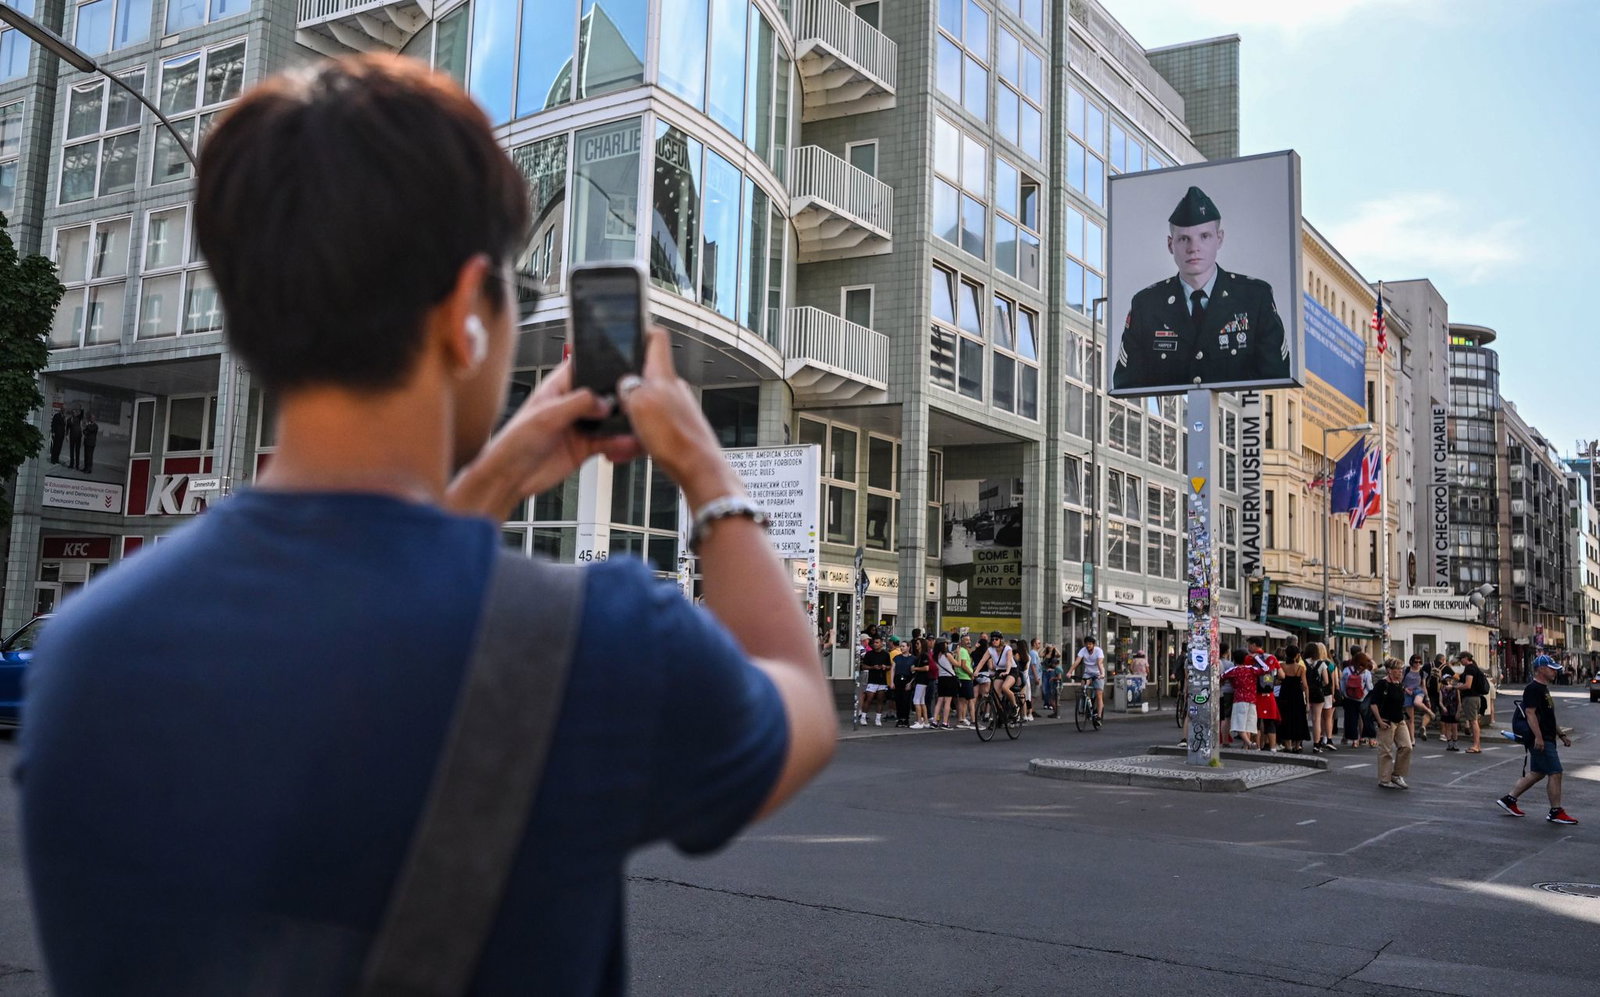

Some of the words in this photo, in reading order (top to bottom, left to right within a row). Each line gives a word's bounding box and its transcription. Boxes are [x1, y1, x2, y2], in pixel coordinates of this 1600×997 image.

[584, 127, 642, 162] CHARLIE
[1433, 408, 1446, 463] CHARLIE
[756, 450, 782, 459] AMERICAN
[783, 449, 803, 457] SECTOR
[748, 460, 757, 468] OFF
[759, 460, 772, 468] DUTY
[774, 458, 802, 467] FORBIDDEN
[759, 468, 775, 476] RULES
[743, 481, 780, 490] МЕРИКАНСКИЙ
[1242, 417, 1260, 570] MAUERMUSEUM
[1434, 467, 1448, 550] CHECKPONT
[768, 528, 796, 536] IRCULATION
[63, 542, 90, 557] KFC
[781, 541, 801, 550] SEKTOR
[578, 550, 592, 562] 45
[594, 551, 607, 562] 45
[978, 550, 1009, 561] COME
[980, 565, 999, 574] AND
[1003, 564, 1015, 573] BE
[1436, 555, 1448, 577] AM
[829, 571, 849, 584] CHARLIE
[874, 577, 899, 588] MUSEUMSS
[977, 577, 1003, 586] PART
[1008, 577, 1021, 586] OF
[946, 598, 968, 606] MAUER
[1412, 600, 1431, 609] ARMY
[1433, 600, 1472, 610] CHECKPOINT
